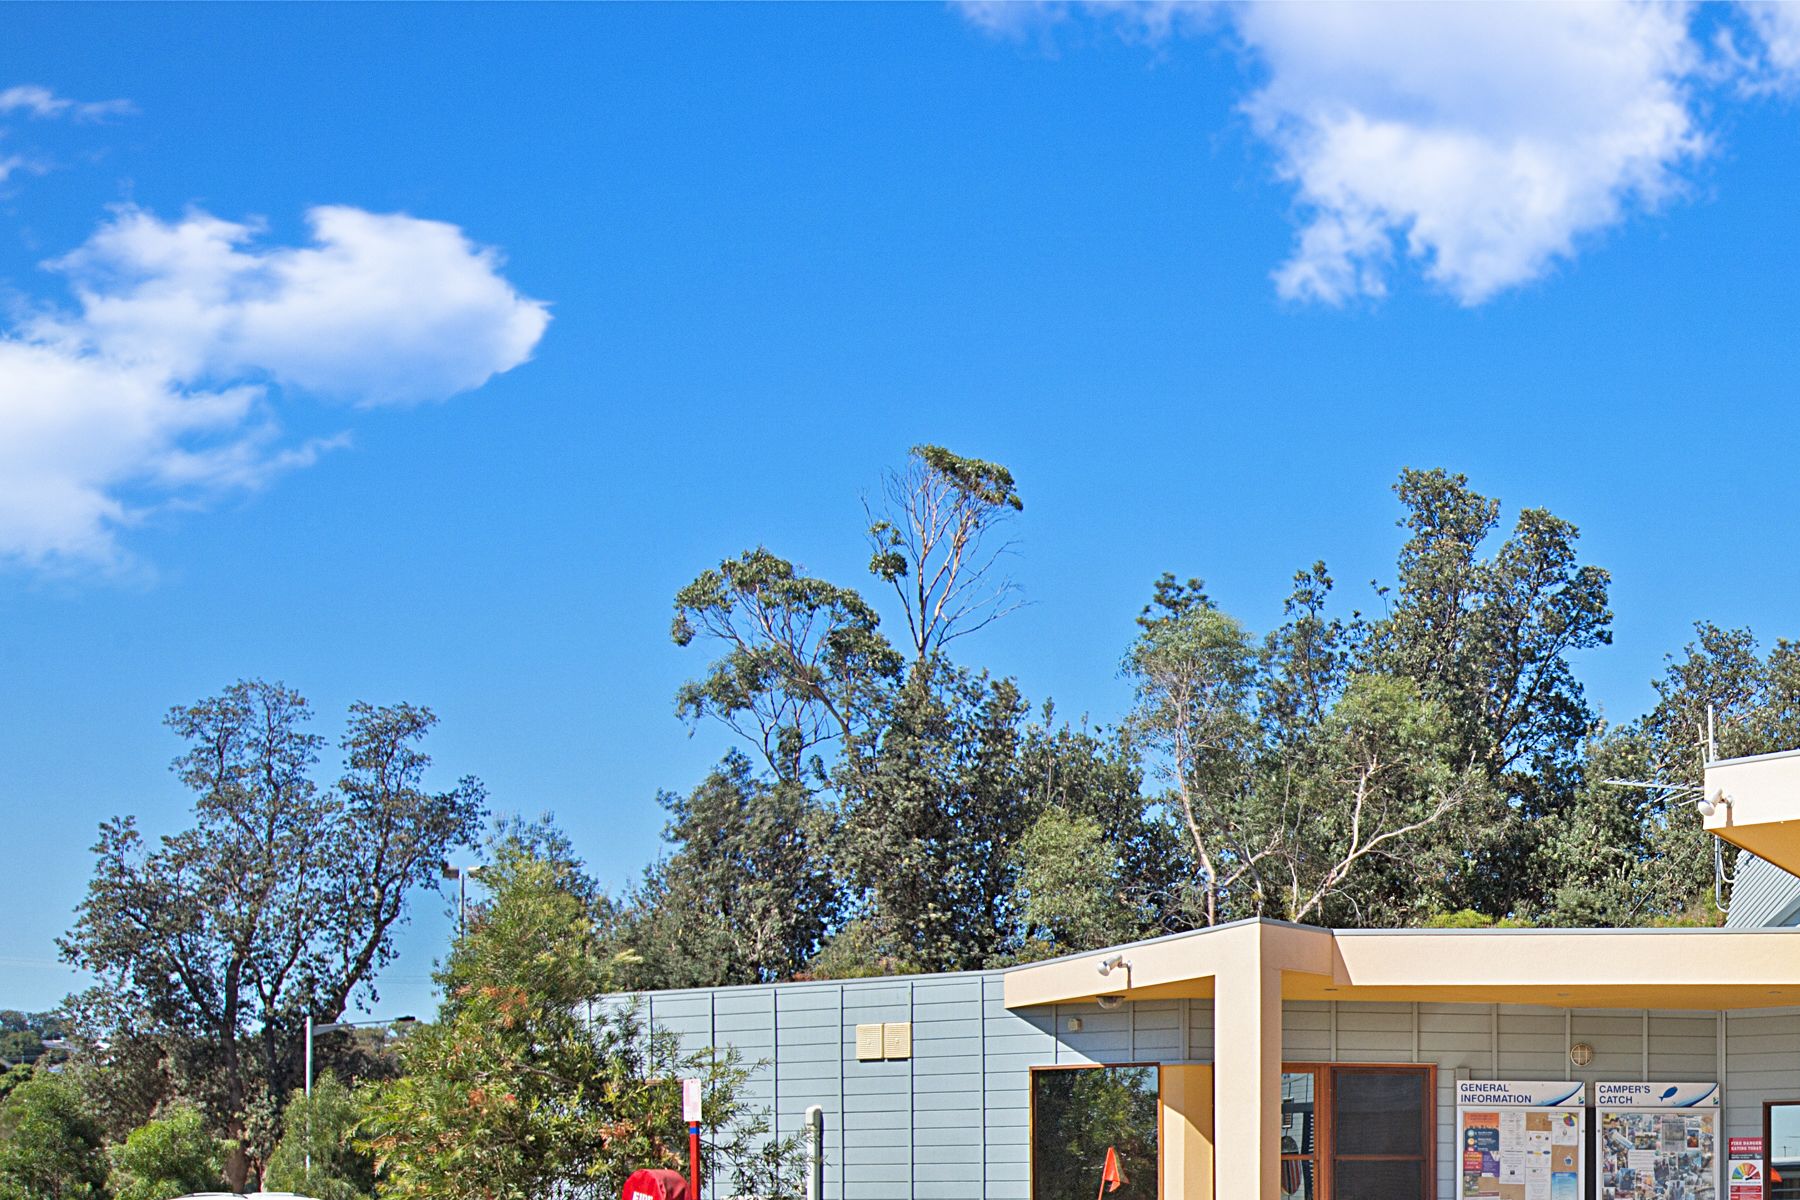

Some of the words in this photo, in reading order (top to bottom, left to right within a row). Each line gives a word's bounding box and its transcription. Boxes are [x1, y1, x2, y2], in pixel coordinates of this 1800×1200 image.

[1460, 1083, 1510, 1092] GENERAL
[1599, 1084, 1651, 1094] CAMPER'S
[1460, 1094, 1532, 1103] INFORMATION
[1599, 1095, 1633, 1104] CATCH
